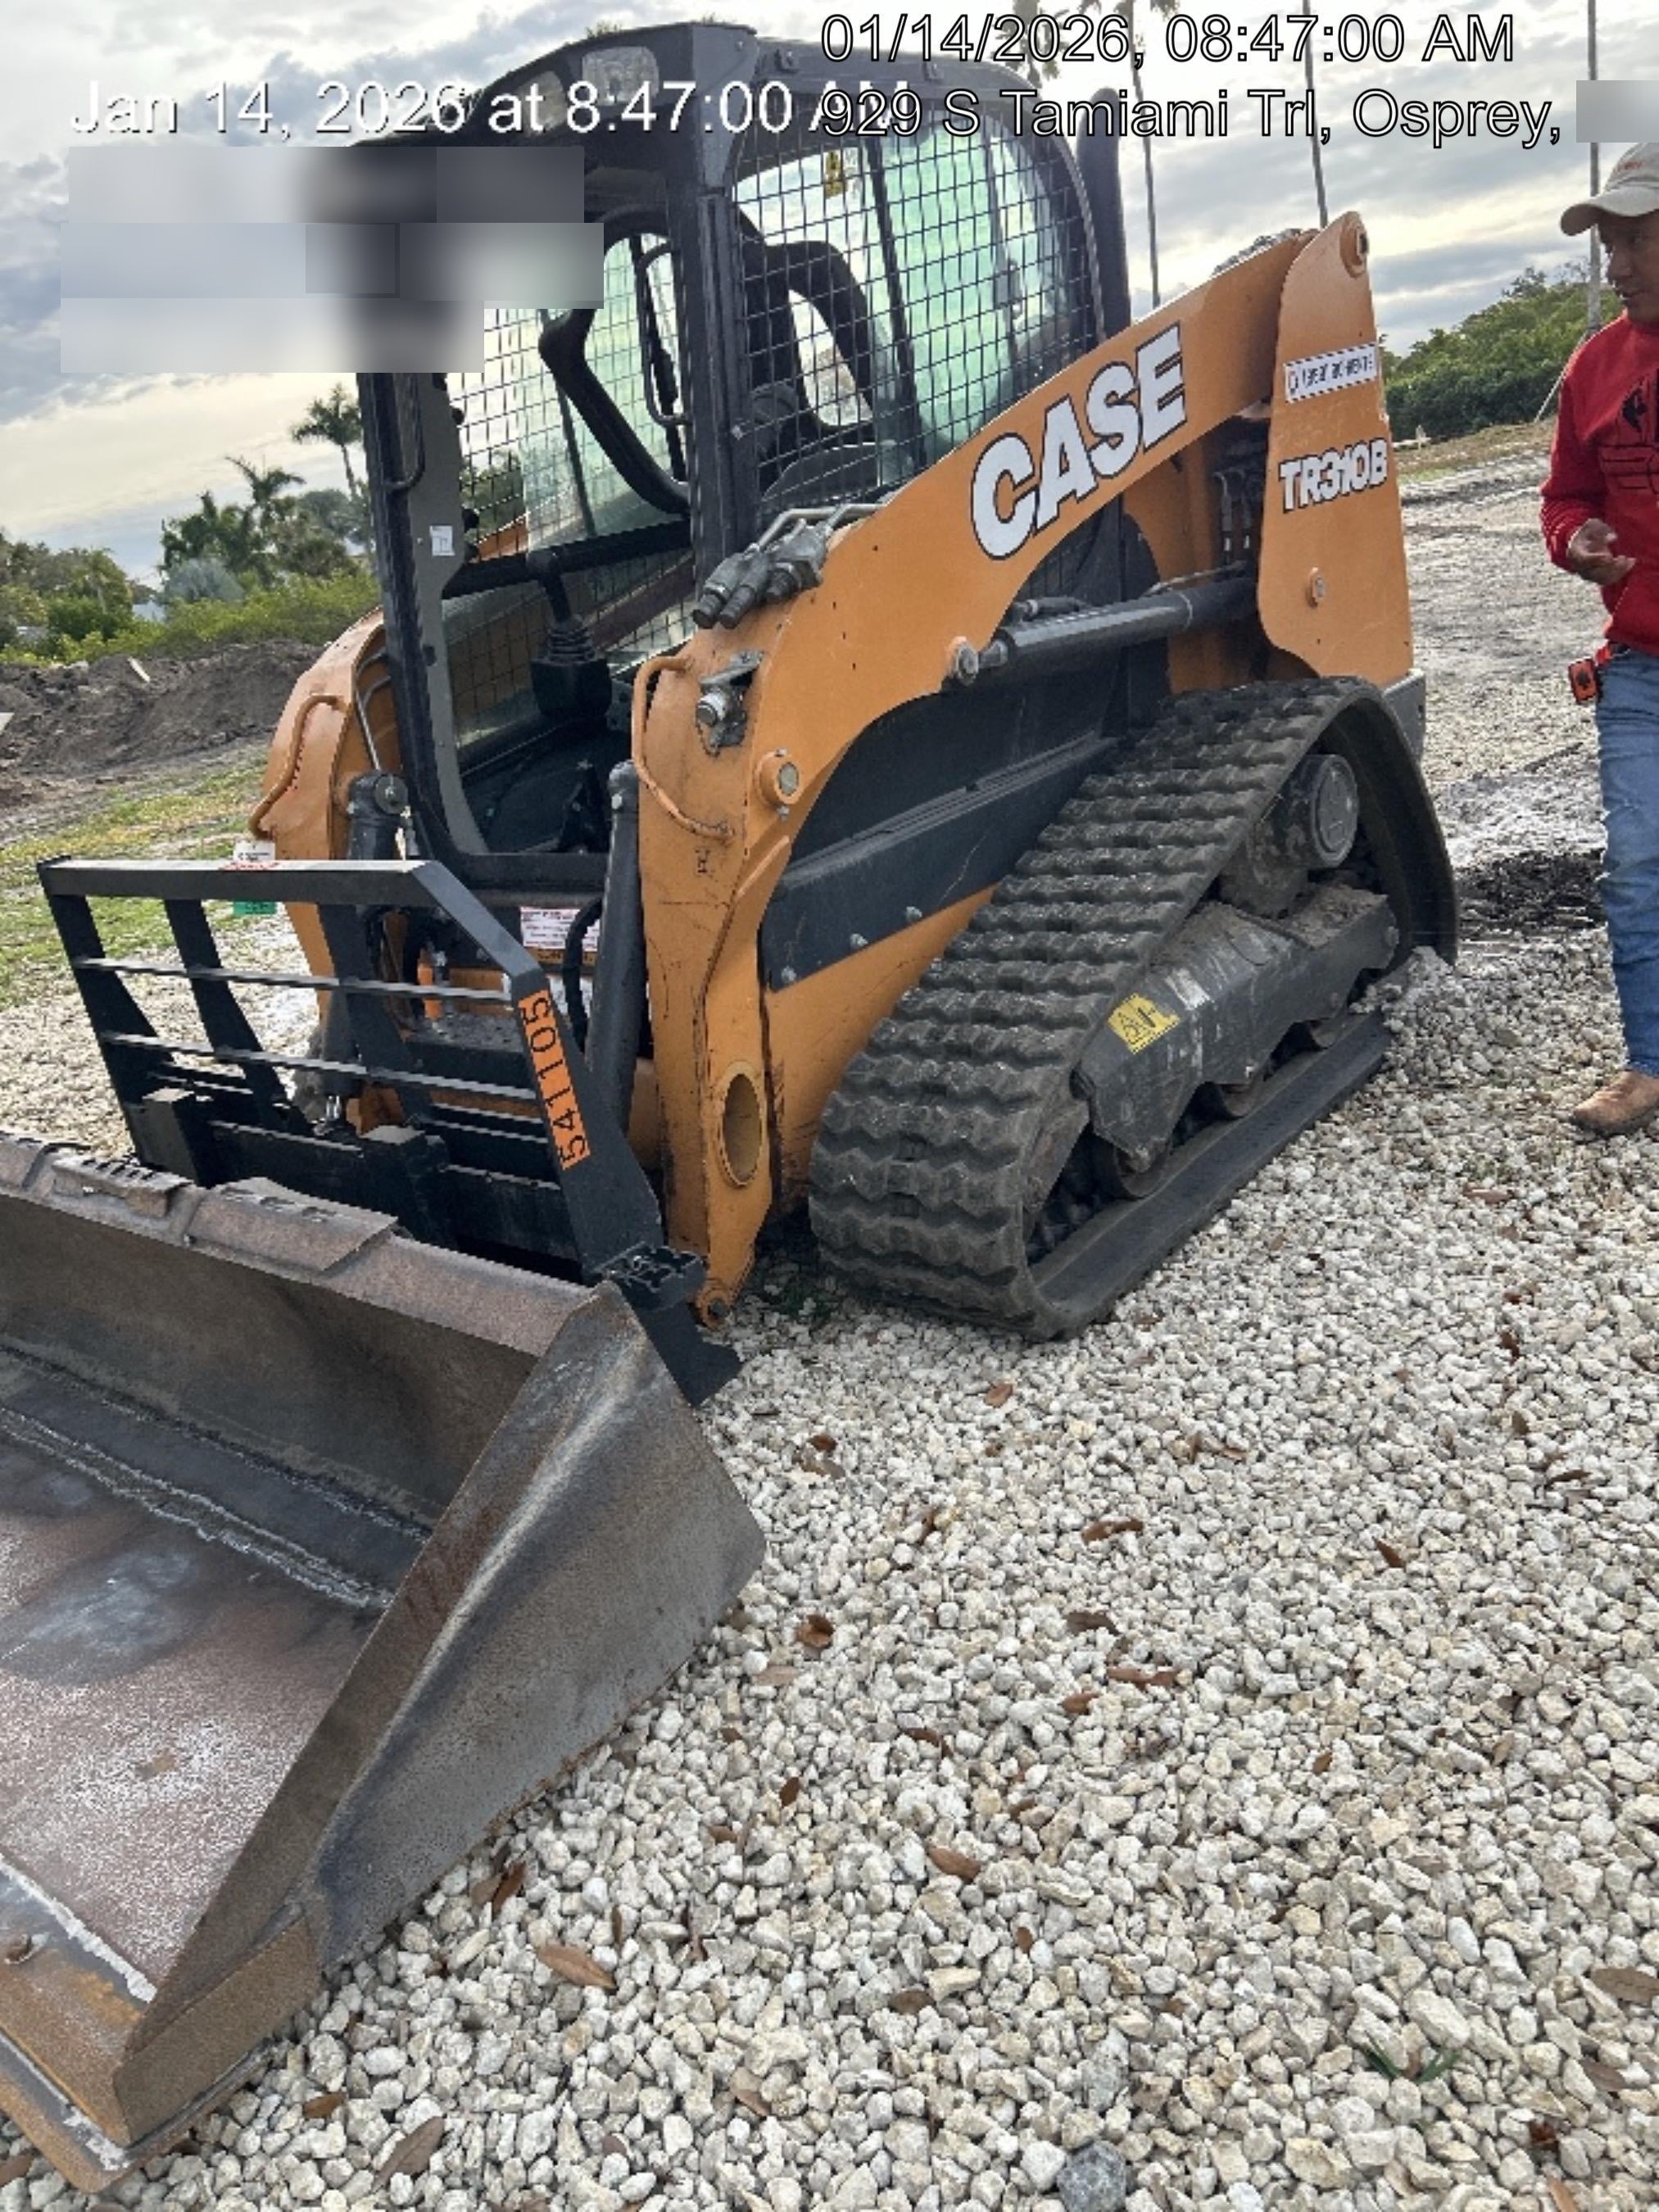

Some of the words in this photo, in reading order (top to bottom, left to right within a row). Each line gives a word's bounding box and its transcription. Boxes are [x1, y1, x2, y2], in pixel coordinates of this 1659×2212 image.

[971, 320, 1187, 560] CASE
[1278, 437, 1387, 514] TR310B
[520, 997, 587, 1163] 541105
